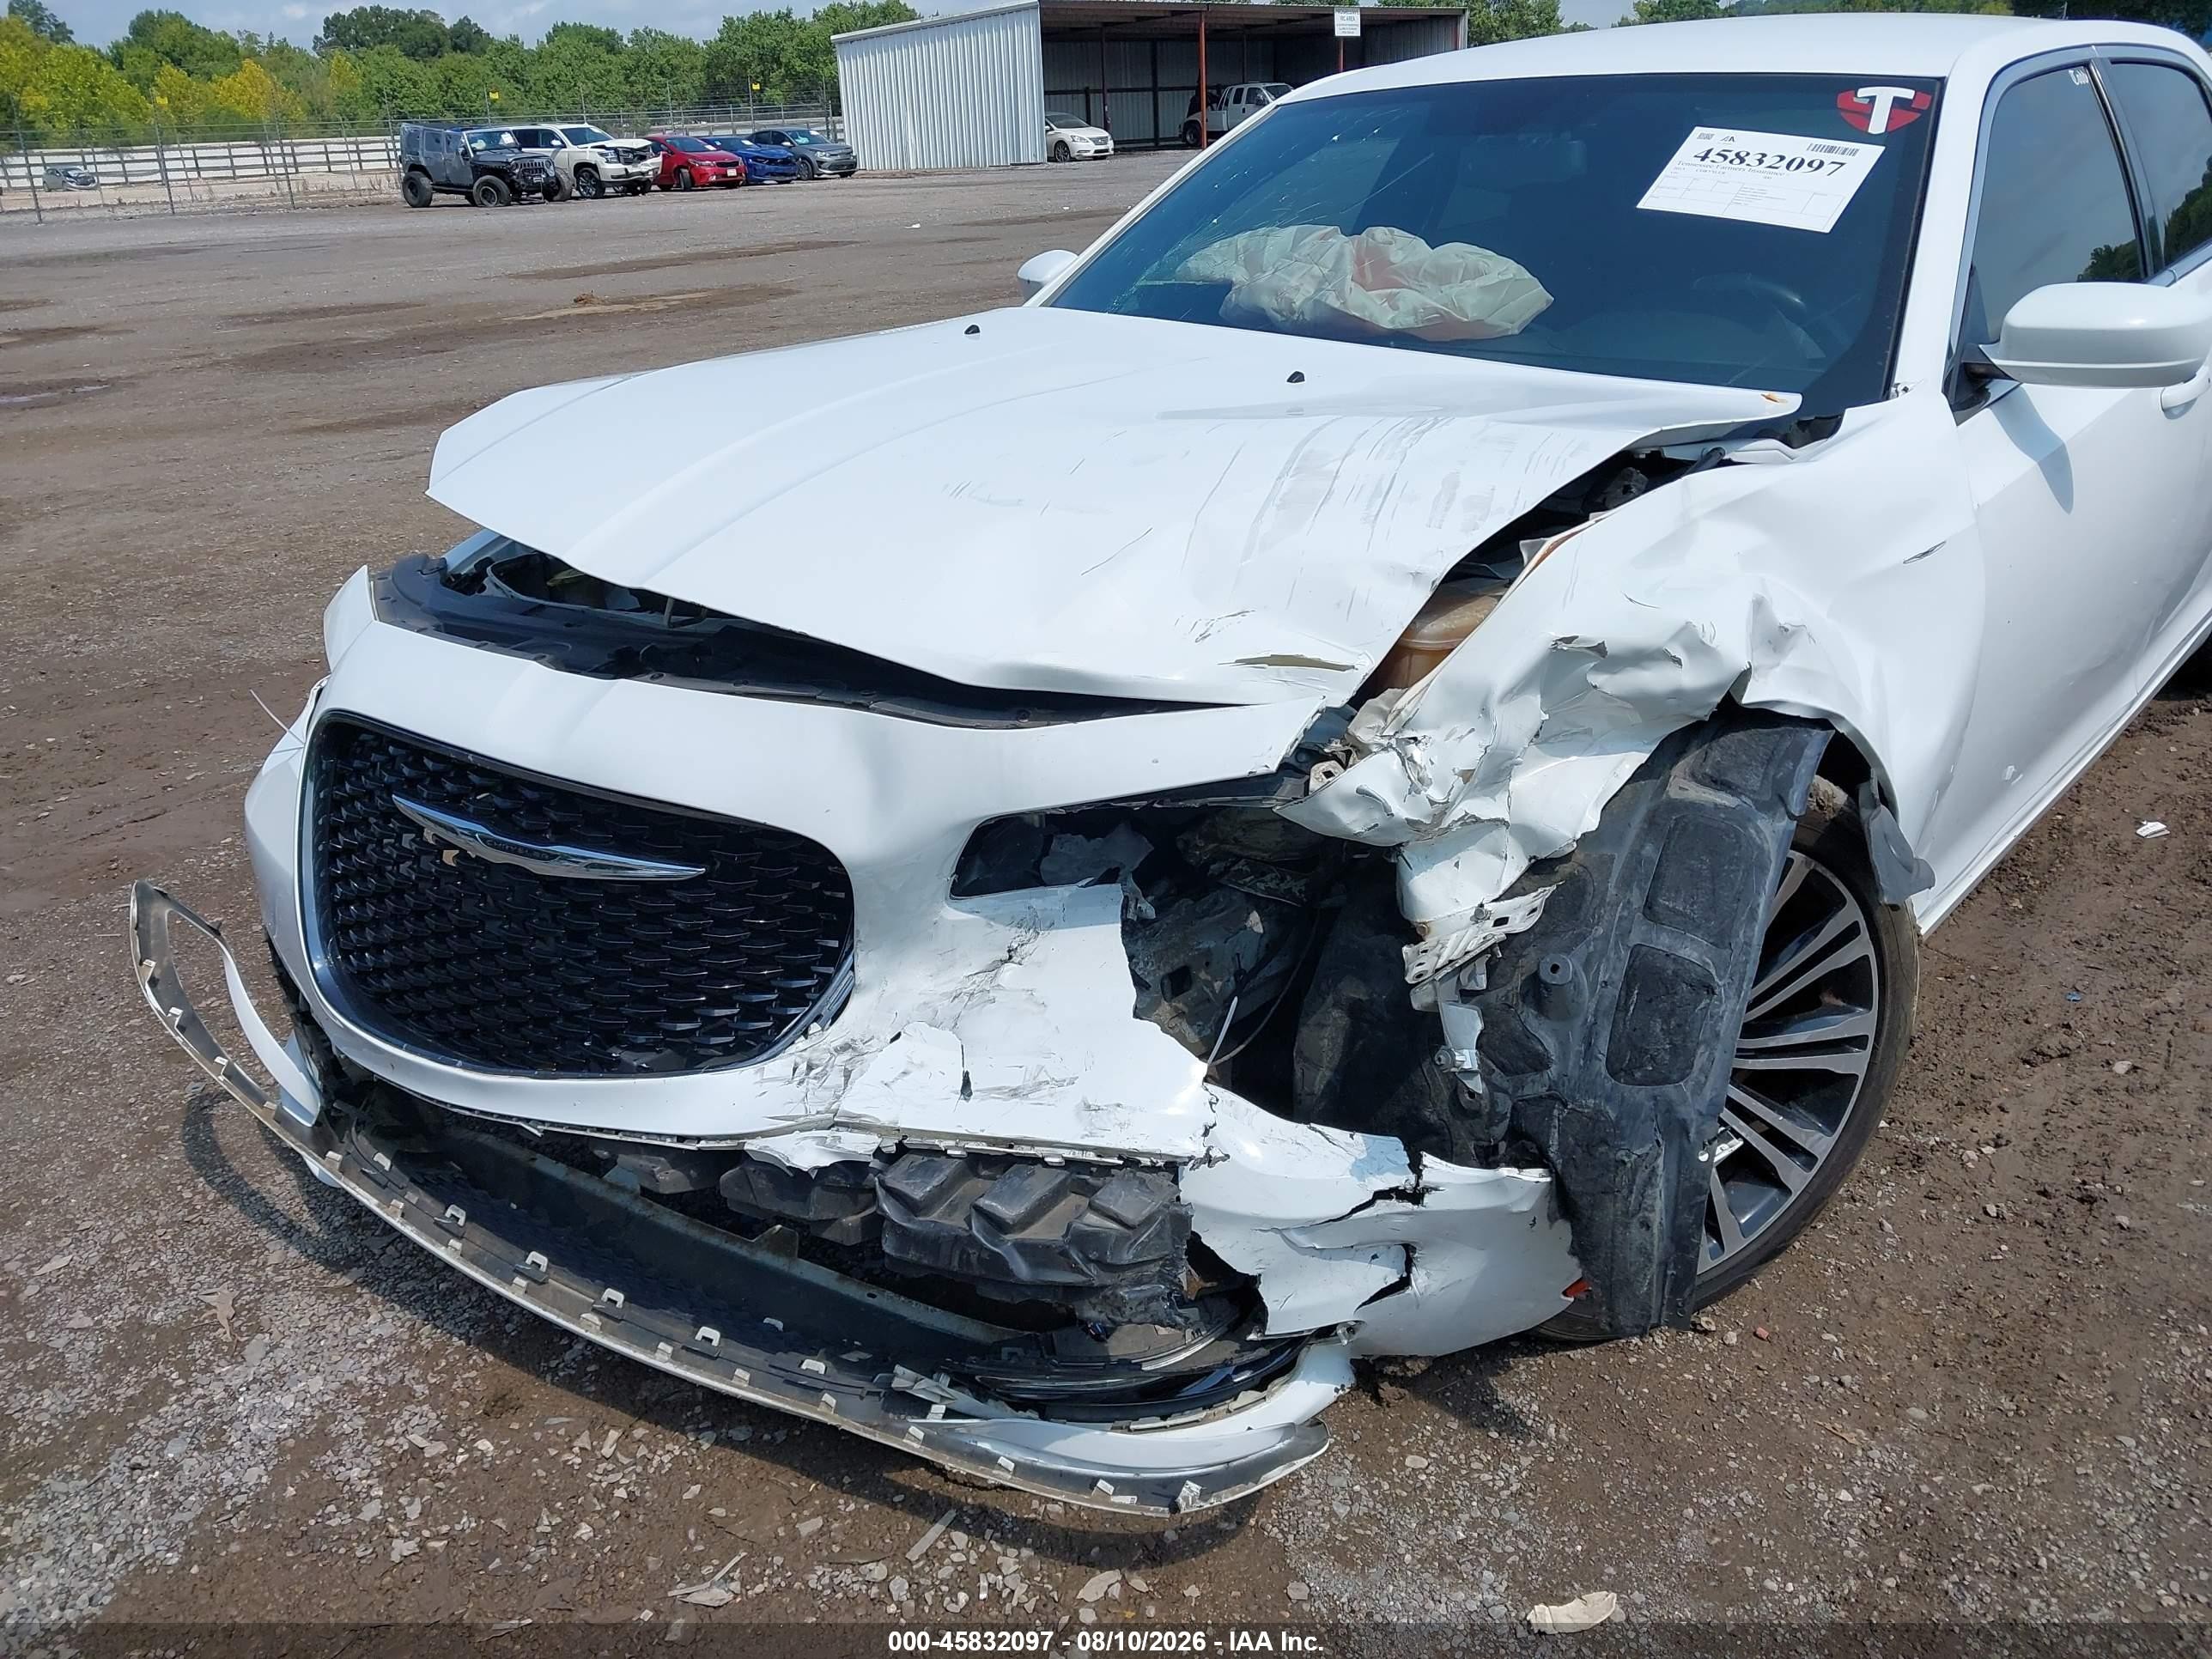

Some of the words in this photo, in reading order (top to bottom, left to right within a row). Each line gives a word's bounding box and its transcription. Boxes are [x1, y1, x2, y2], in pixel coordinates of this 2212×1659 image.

[1677, 161, 1713, 169] Tennessee
[1716, 164, 1746, 173] Farmers
[1748, 167, 1786, 177] Insurance
[1693, 147, 1847, 177] 45832097
